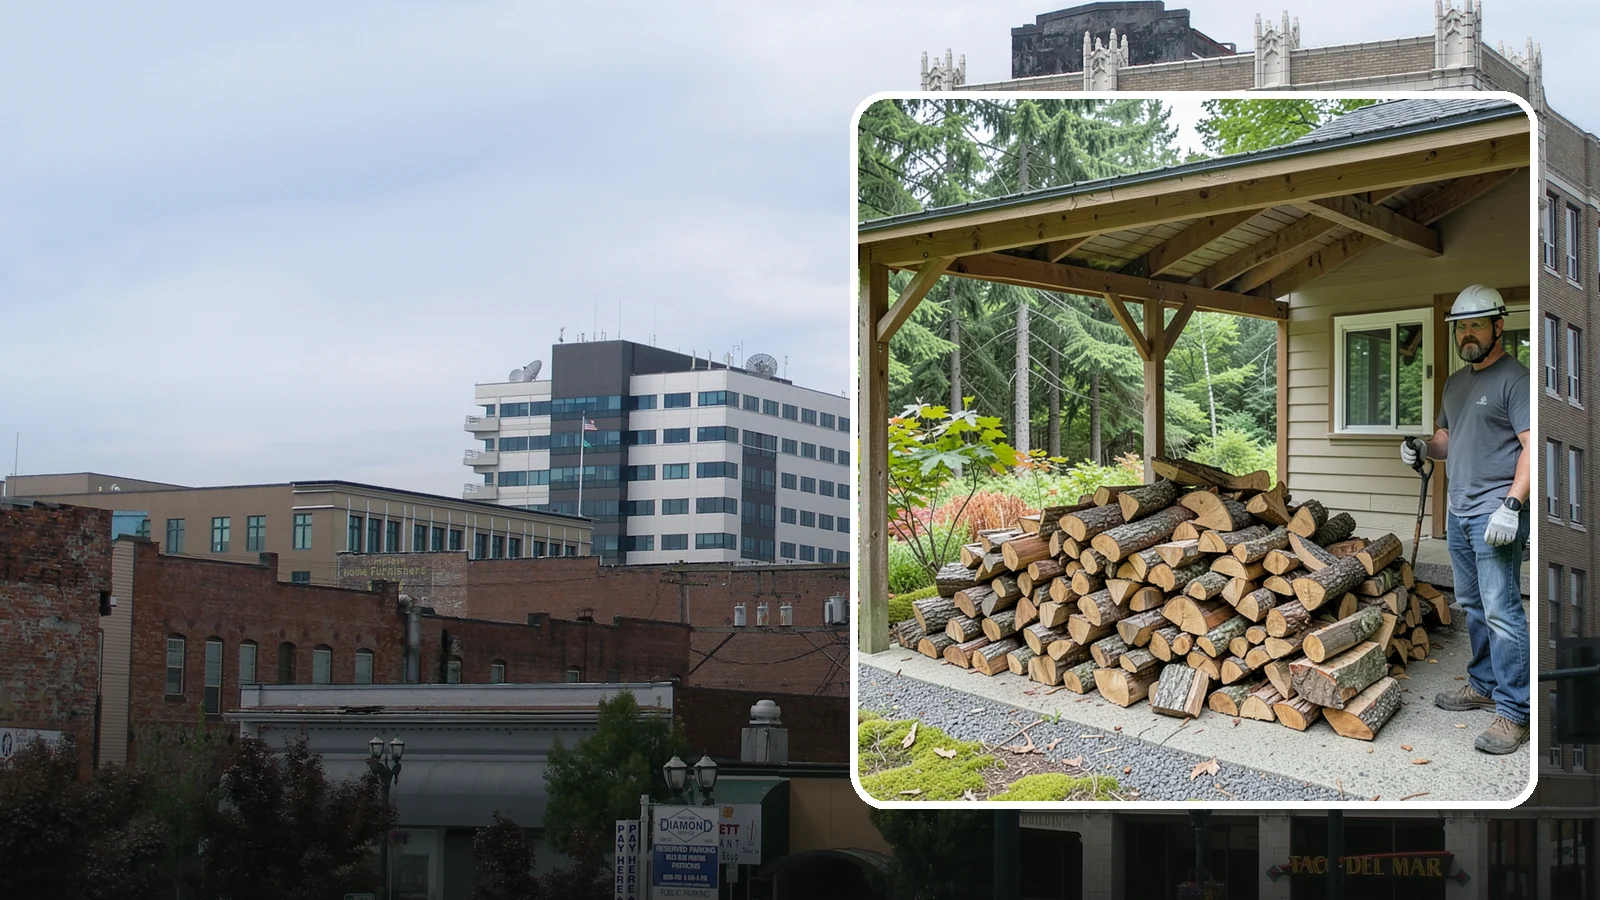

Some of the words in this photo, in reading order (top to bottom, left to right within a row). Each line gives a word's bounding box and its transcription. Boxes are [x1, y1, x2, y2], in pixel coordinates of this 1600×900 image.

[343, 568, 368, 577] Home
[370, 566, 427, 577] Furnishers
[660, 818, 713, 833] DIAMOND
[1022, 815, 1070, 828] BUILDING
[628, 825, 637, 852] PAY
[656, 845, 688, 853] RESERVED
[689, 846, 716, 854] PARKING
[722, 852, 739, 862] Soup
[671, 862, 701, 870] PATRONS
[1346, 856, 1385, 876] DEL
[1392, 857, 1442, 877] MAR
[617, 856, 625, 893] HERE
[627, 856, 636, 893] HERE
[660, 889, 682, 897] PUBLIC
[684, 889, 710, 898] PARKING
